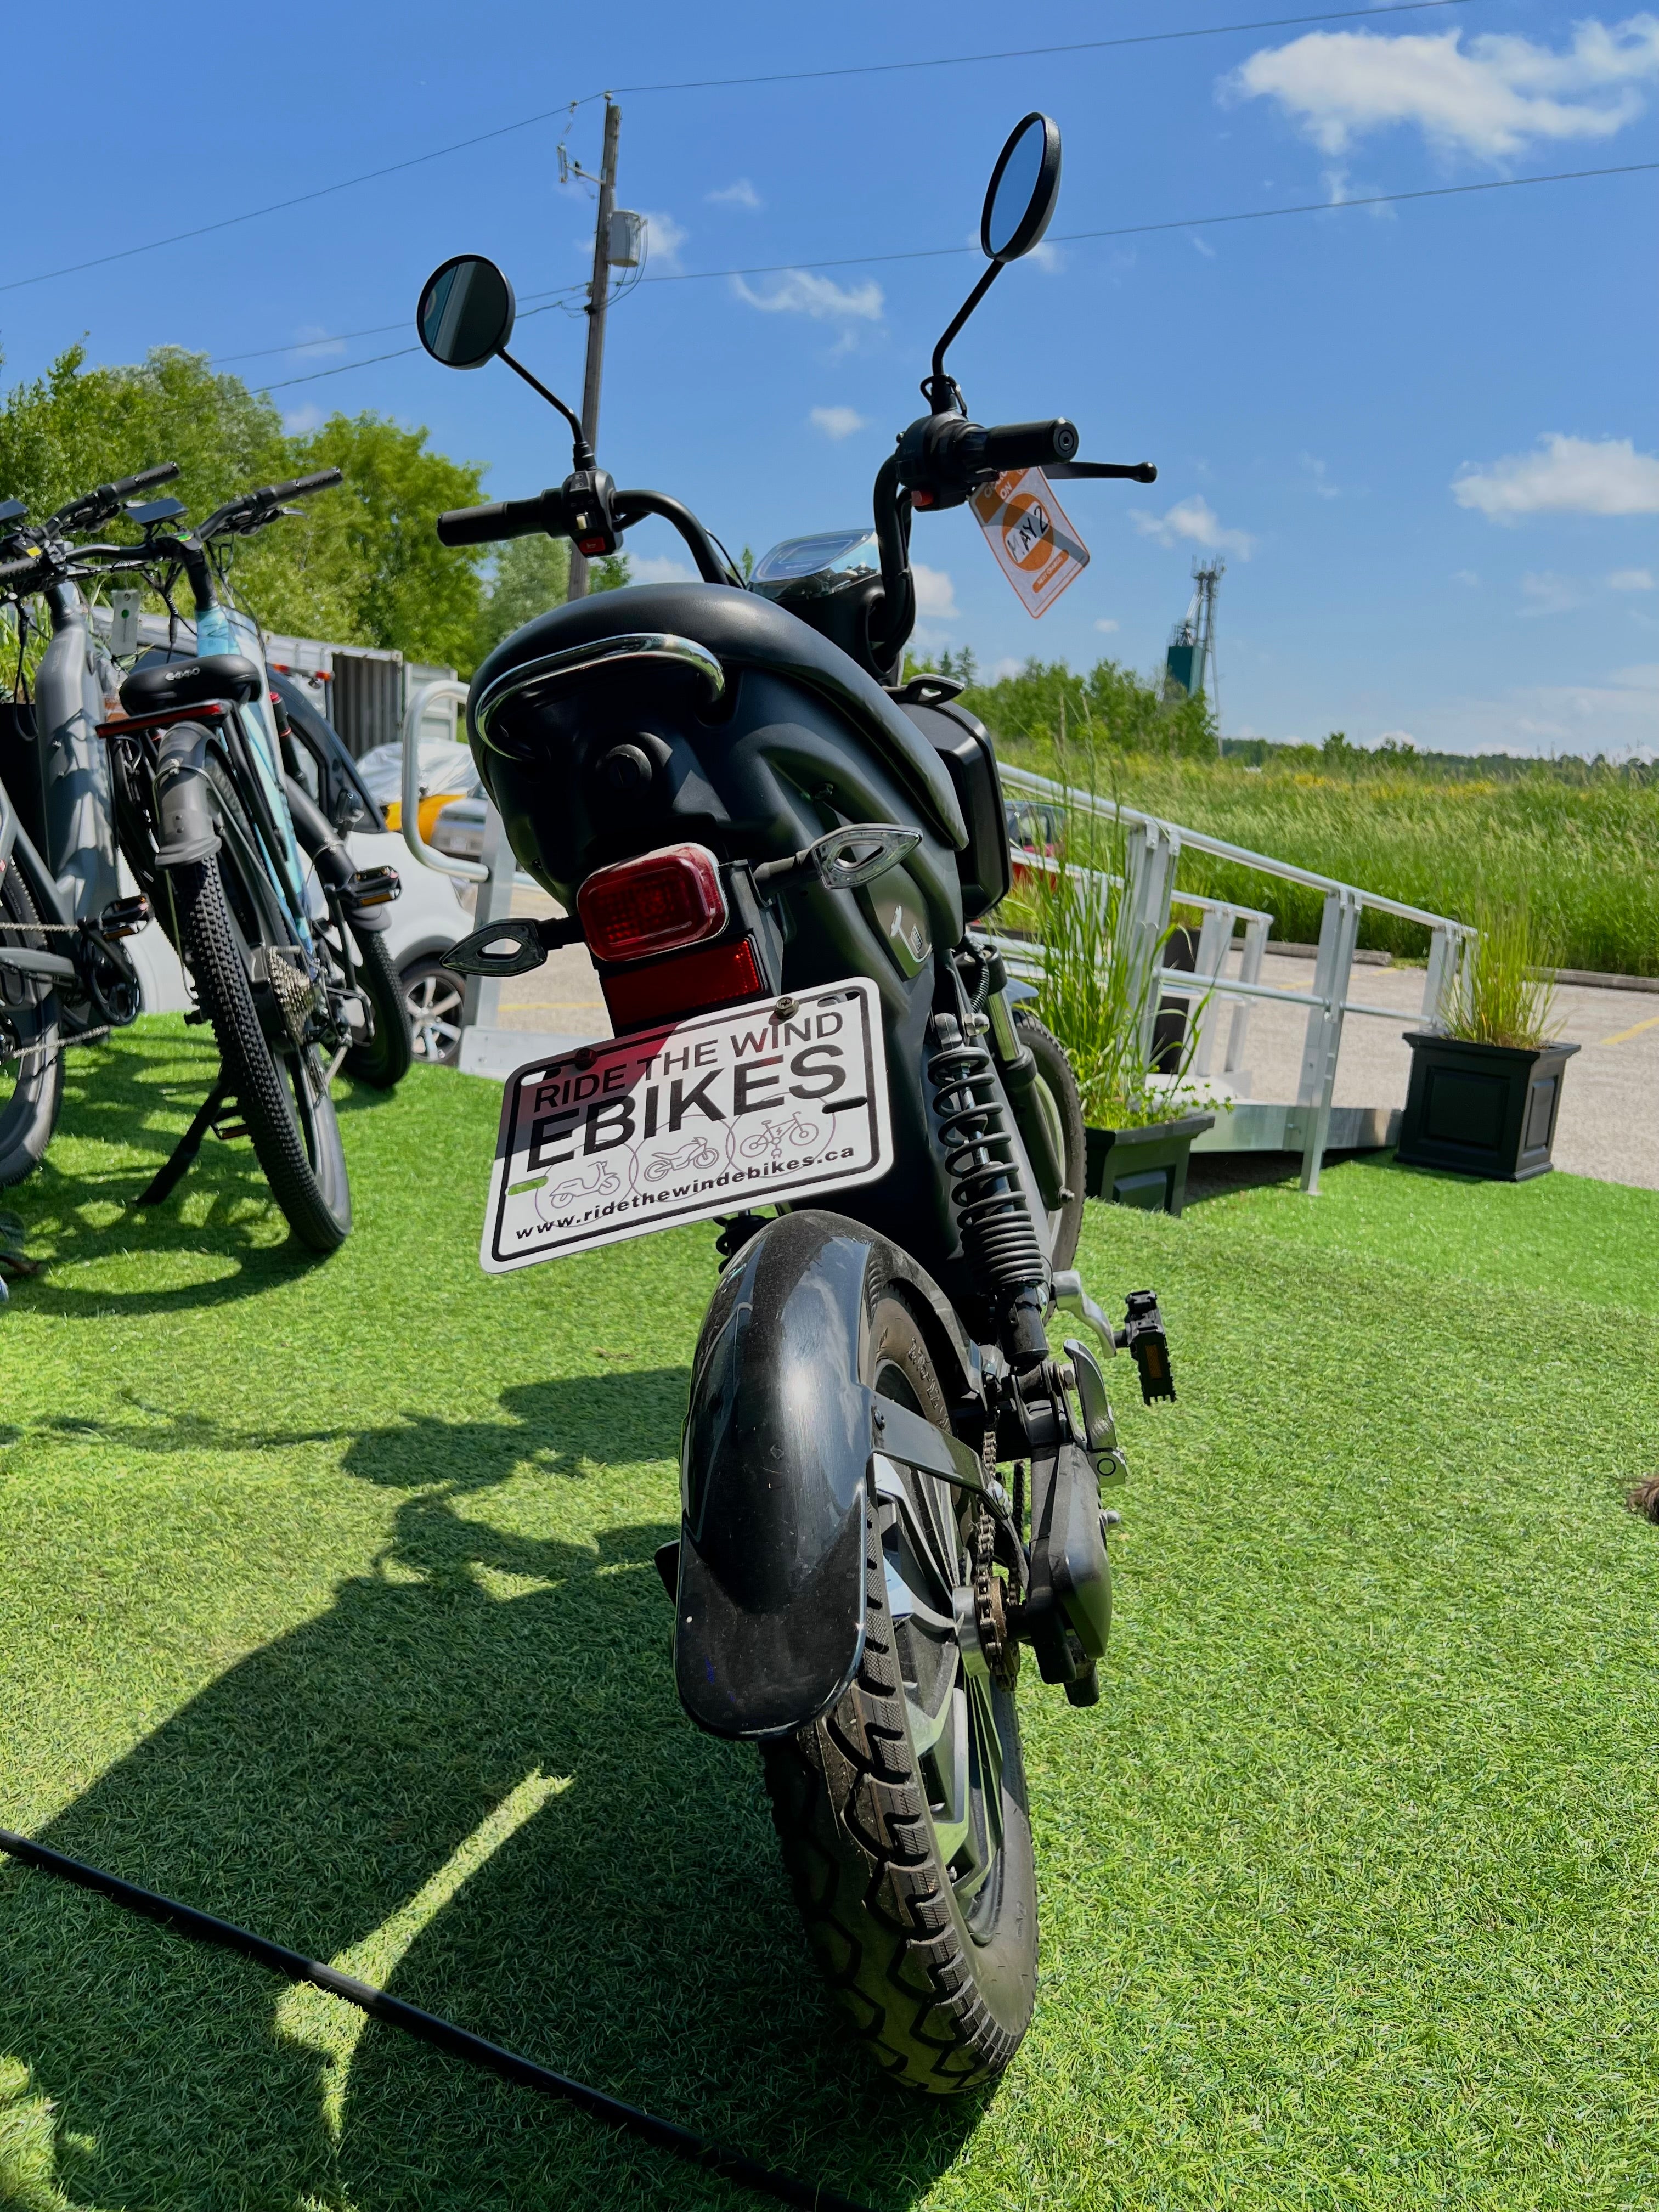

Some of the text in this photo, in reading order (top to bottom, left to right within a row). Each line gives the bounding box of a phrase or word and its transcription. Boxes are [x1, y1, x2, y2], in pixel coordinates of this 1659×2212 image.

[1000, 482, 1013, 500] ON
[527, 1045, 846, 1171] EBIKES
[533, 1012, 843, 1113] RIDE THE WIND
[516, 1147, 855, 1239] www.ridethewindebikes.ca
